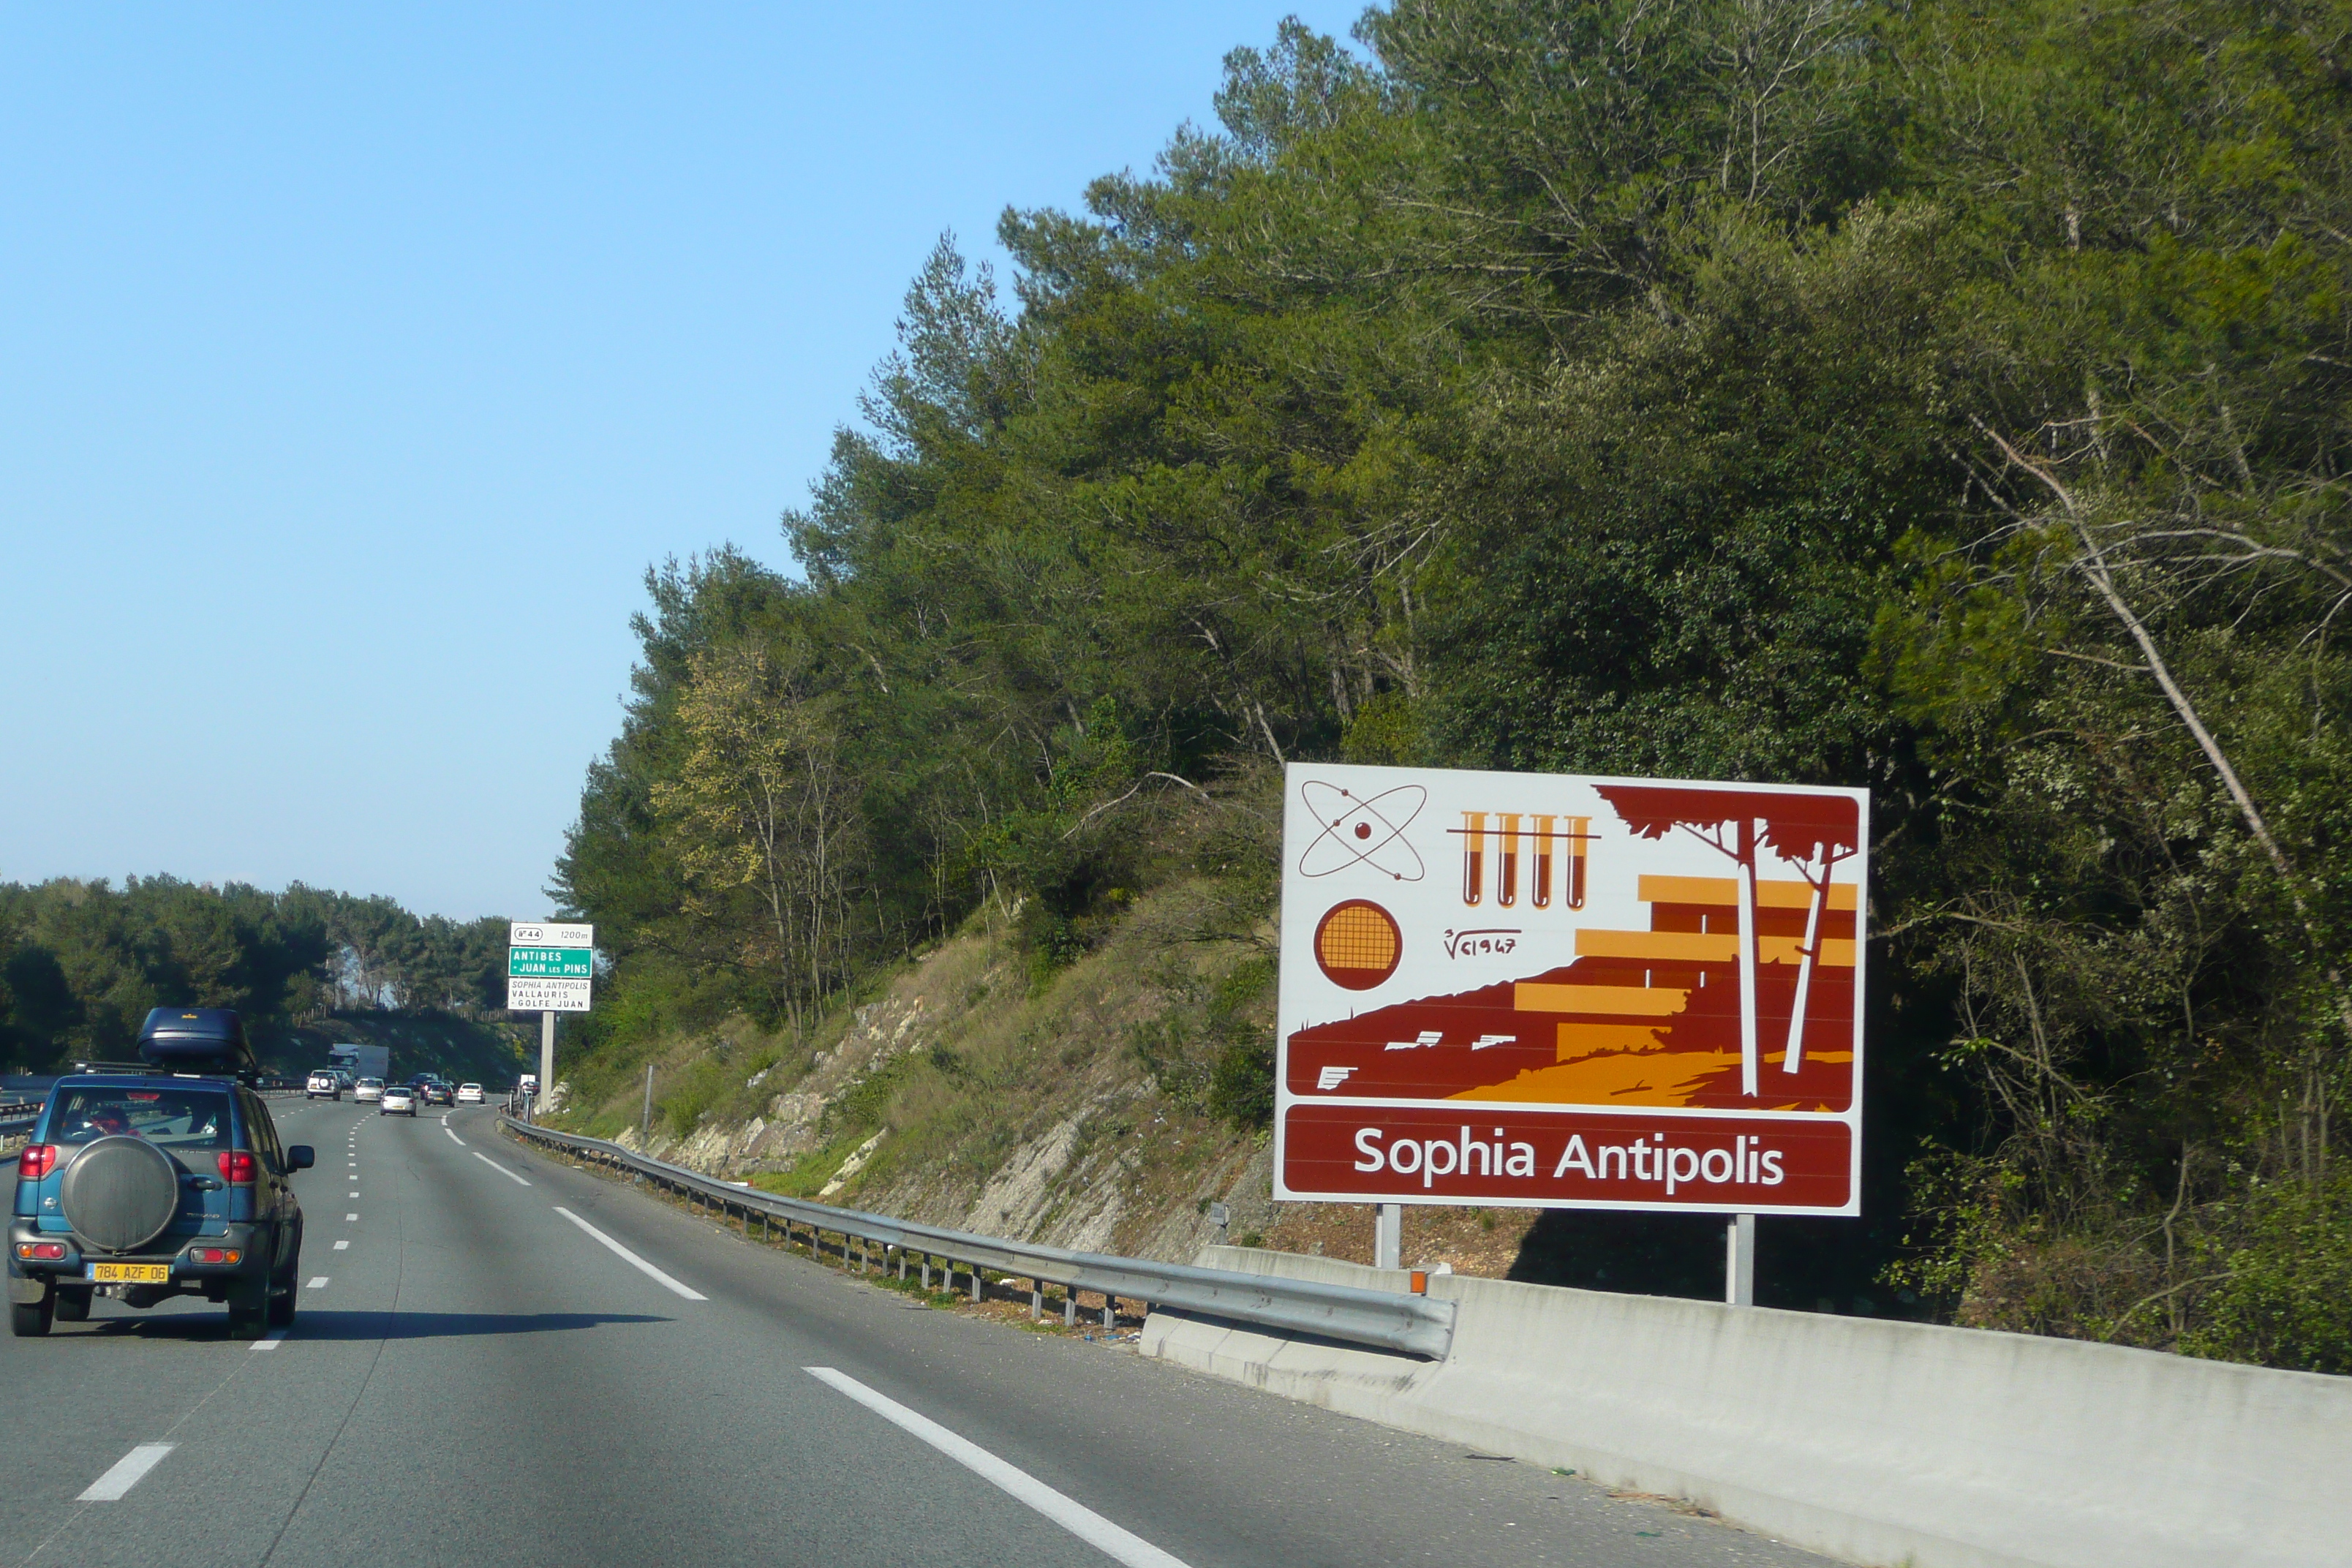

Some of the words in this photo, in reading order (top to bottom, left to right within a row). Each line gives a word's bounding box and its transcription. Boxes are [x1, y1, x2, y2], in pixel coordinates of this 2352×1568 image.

[513, 951, 562, 961] ANTIBES
[519, 963, 546, 973] JUAN
[564, 964, 587, 973] PINS
[512, 981, 541, 989] SOPHIA
[546, 981, 588, 990] ANTIPOLIS
[512, 990, 568, 998] VALLAURIS
[1354, 1126, 1535, 1188] Sophia
[1553, 1133, 1784, 1194] Antipolis
[97, 1265, 118, 1278] 784
[124, 1267, 146, 1279] AZF
[151, 1267, 166, 1279] 06
